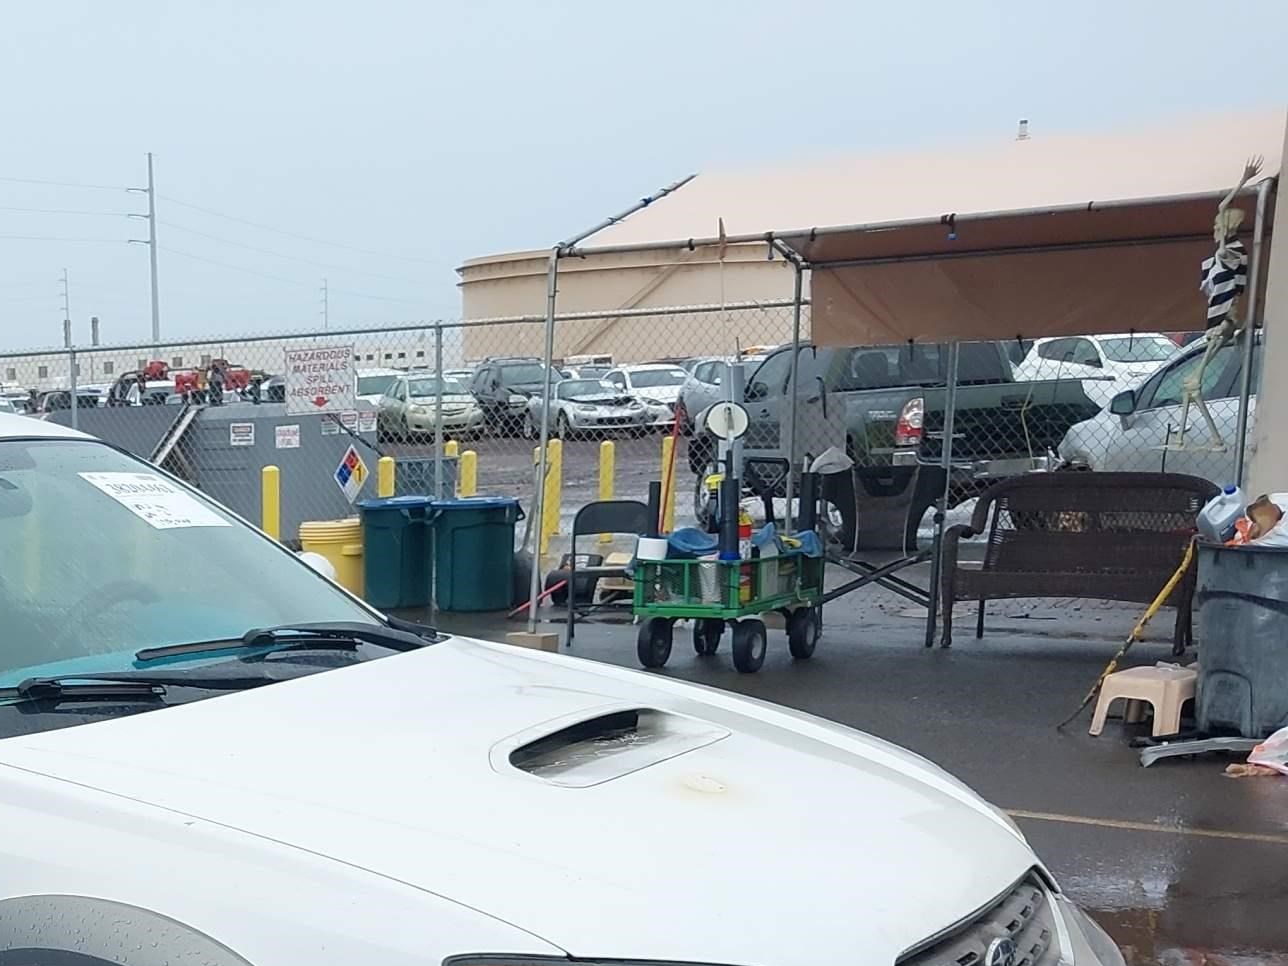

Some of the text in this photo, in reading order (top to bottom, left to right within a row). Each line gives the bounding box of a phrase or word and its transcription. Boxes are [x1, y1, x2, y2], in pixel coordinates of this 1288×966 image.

[288, 349, 351, 362] HAZARDOUS
[292, 361, 348, 374] MATERIALS
[306, 374, 333, 385] SPILL
[290, 384, 351, 397] ABSORBENT
